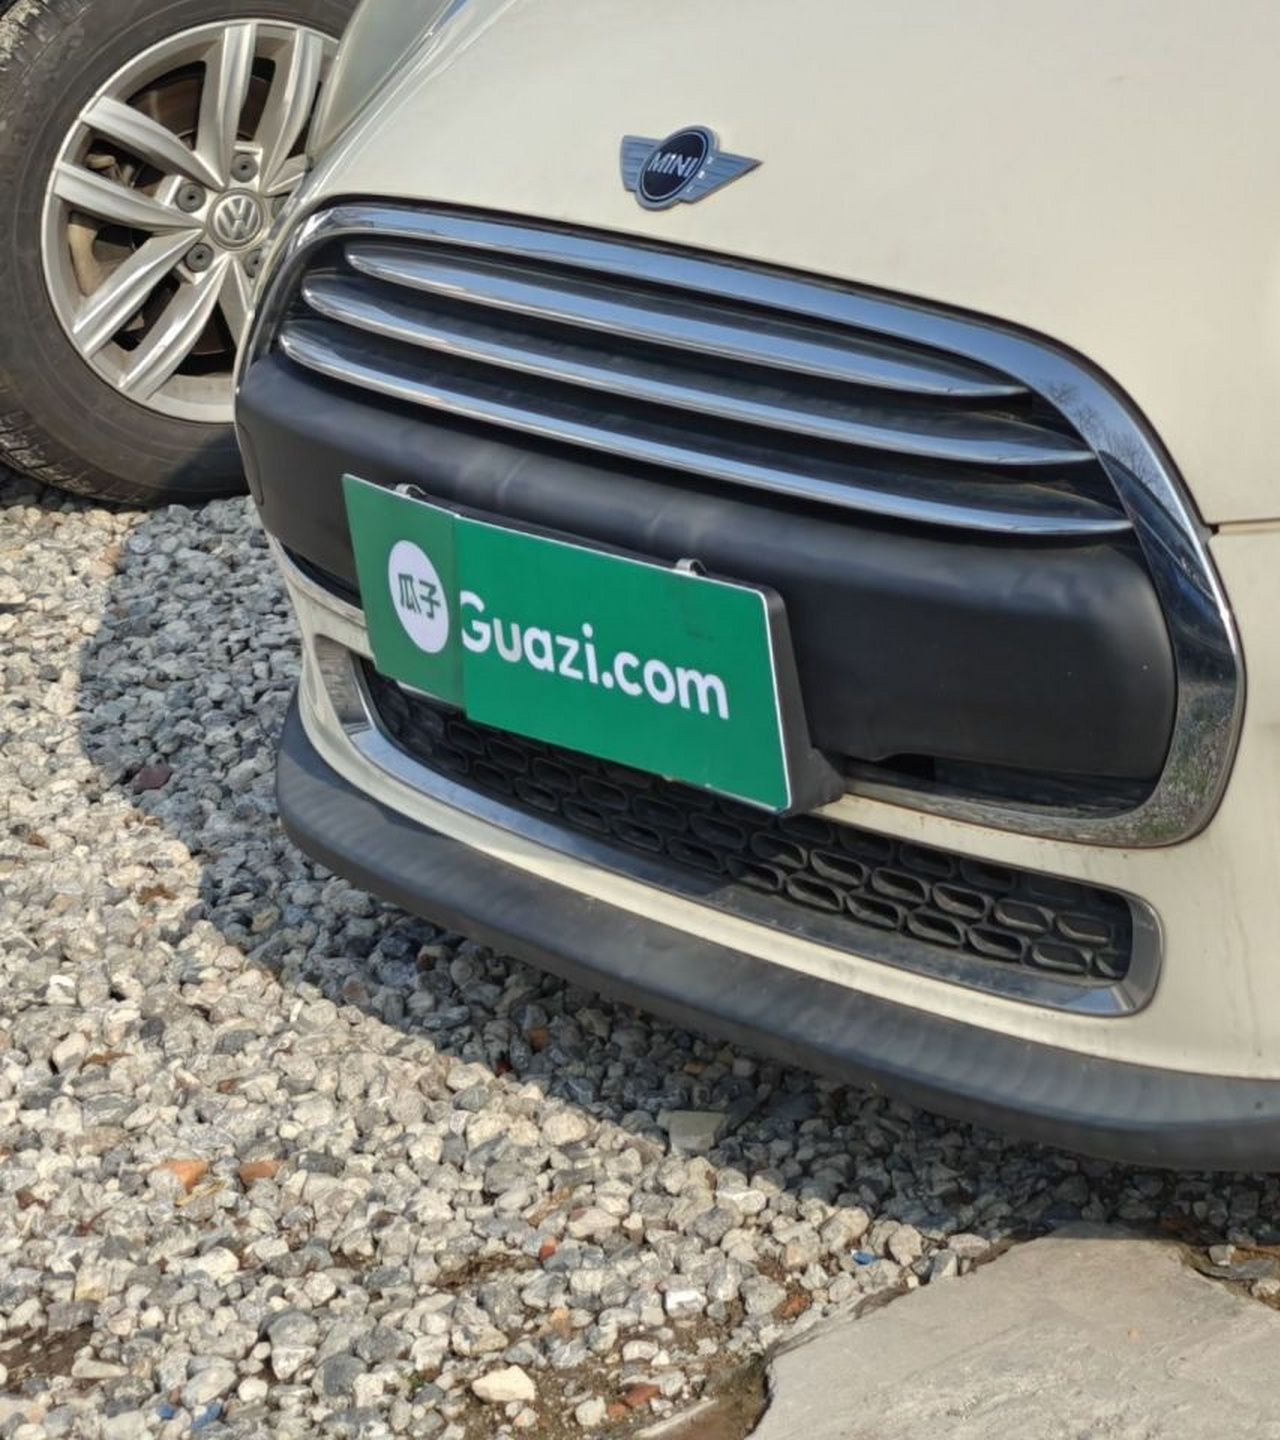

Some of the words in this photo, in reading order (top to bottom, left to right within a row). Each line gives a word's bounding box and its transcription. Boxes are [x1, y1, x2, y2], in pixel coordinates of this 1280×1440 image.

[648, 151, 698, 177] MINI
[398, 572, 441, 620] 瓜子
[460, 589, 729, 721] Guazi.com
